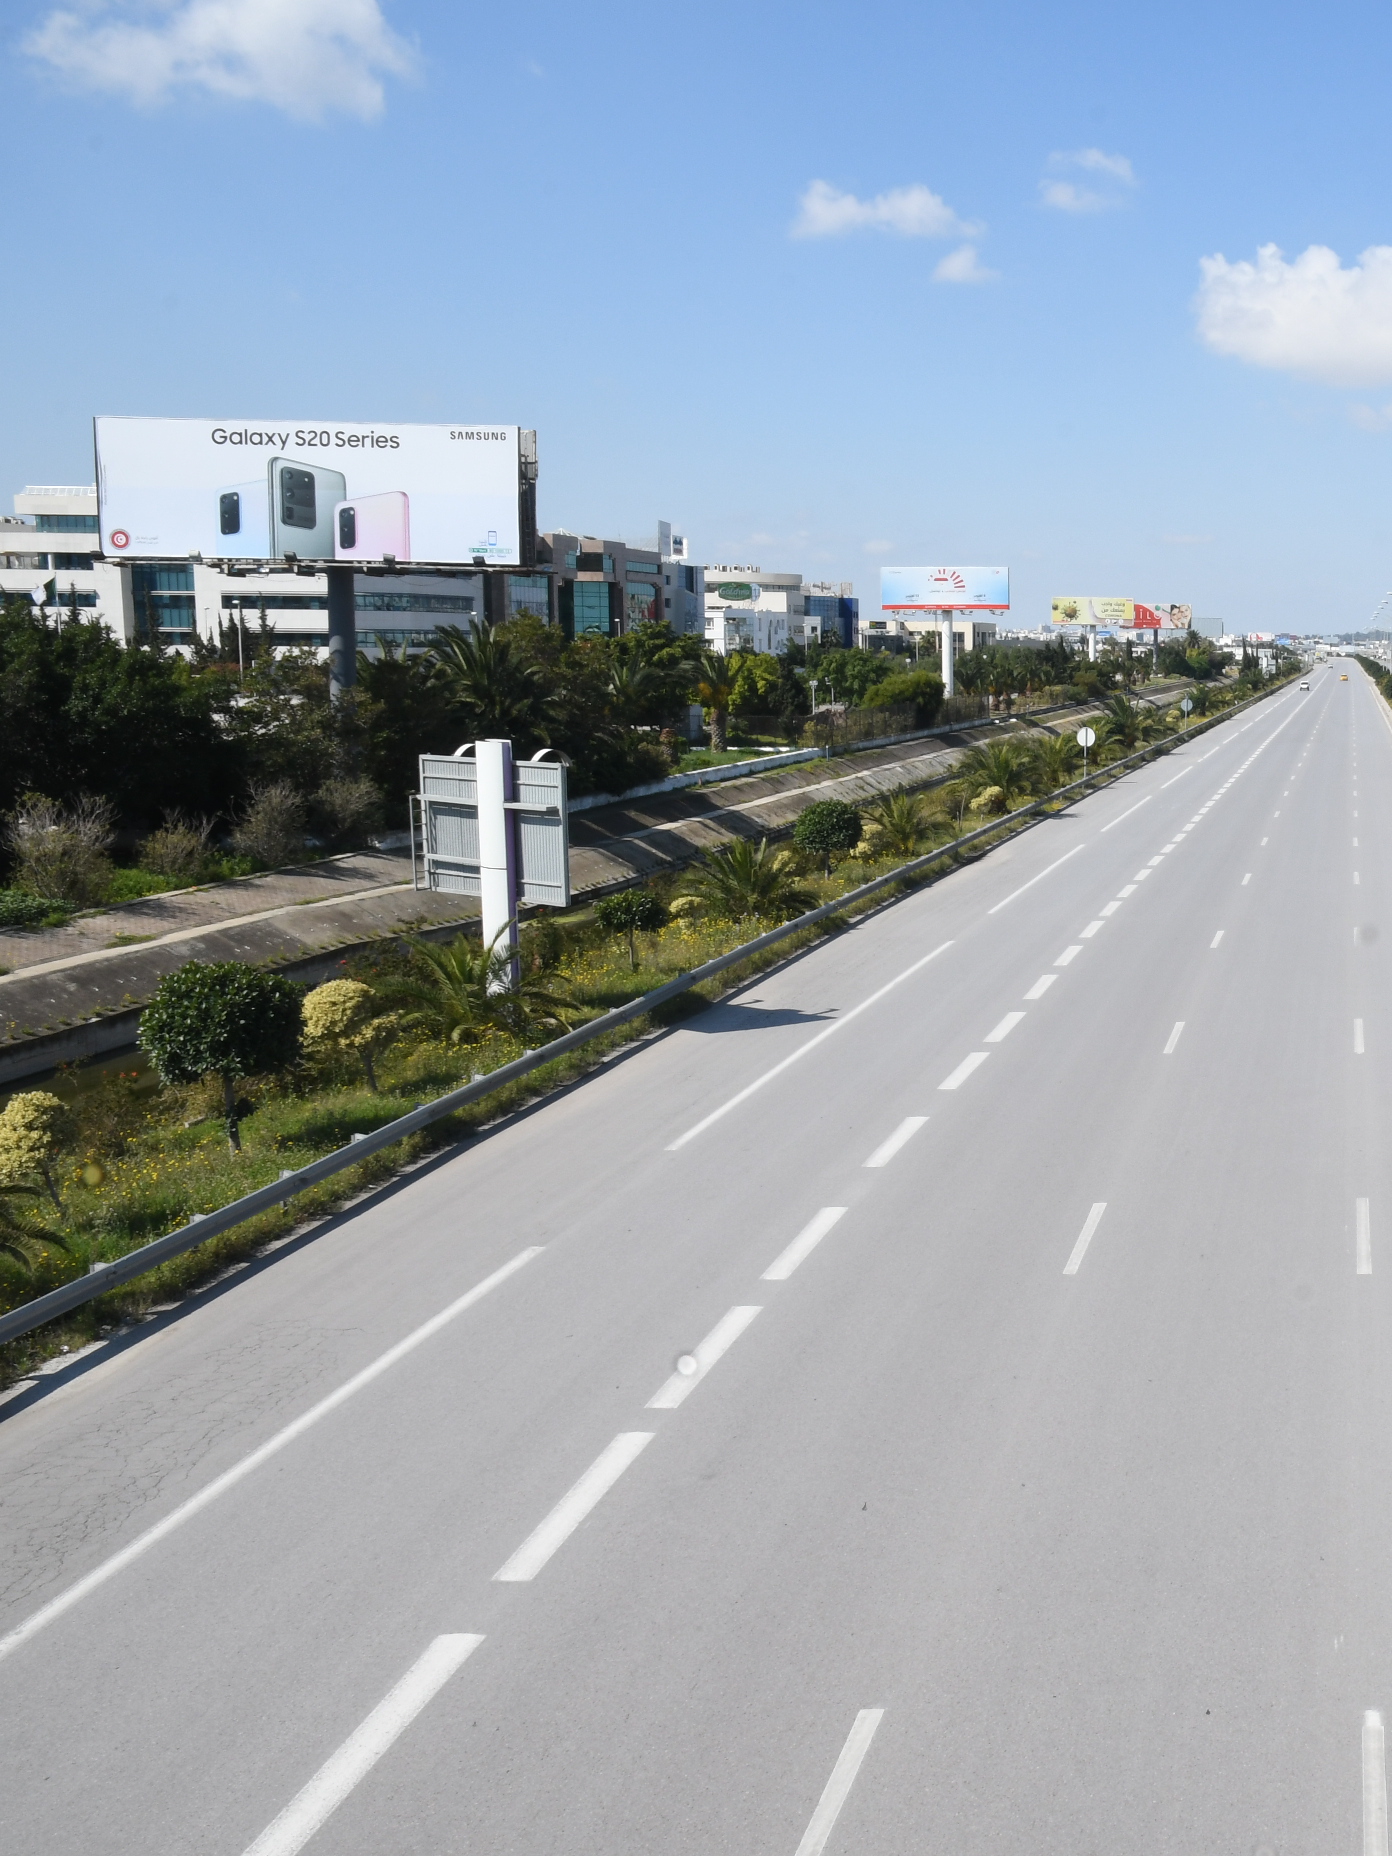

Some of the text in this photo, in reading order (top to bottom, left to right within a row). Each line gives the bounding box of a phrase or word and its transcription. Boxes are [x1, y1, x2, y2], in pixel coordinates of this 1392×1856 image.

[211, 427, 400, 450] Galaxy S20 Series
[450, 430, 507, 441] SAMSUNG
